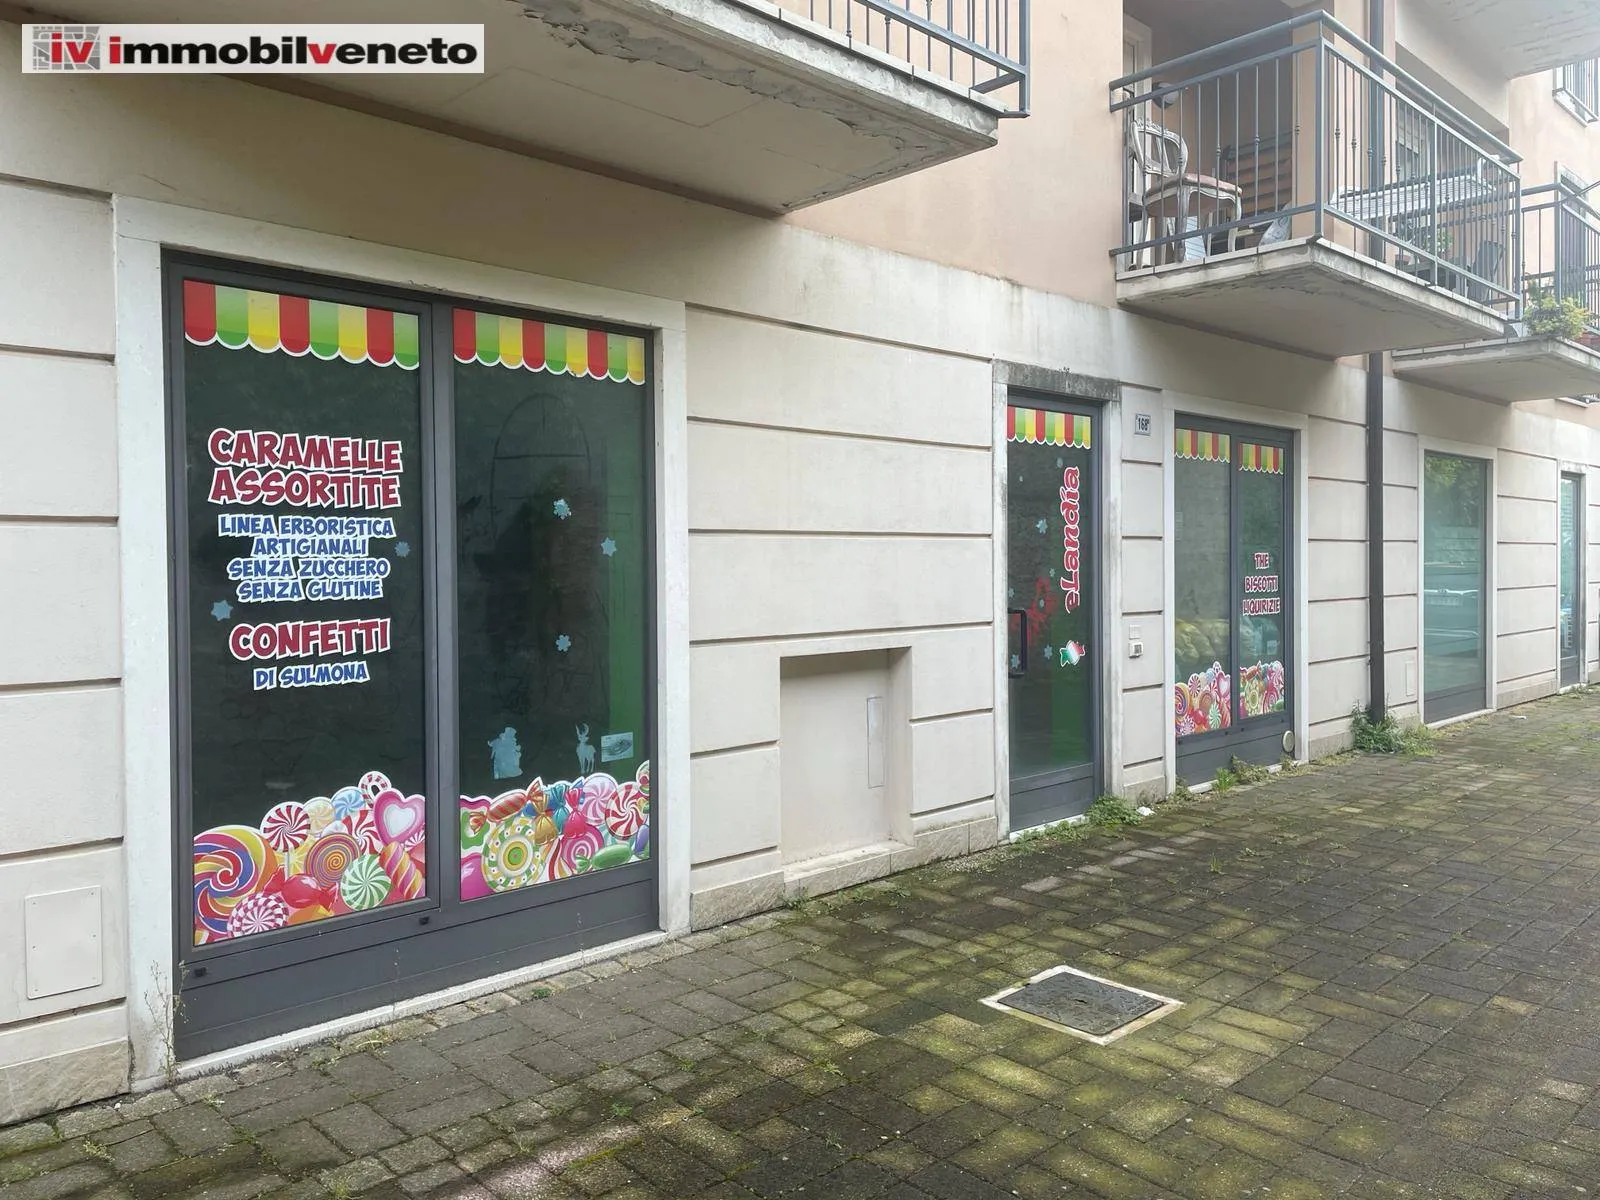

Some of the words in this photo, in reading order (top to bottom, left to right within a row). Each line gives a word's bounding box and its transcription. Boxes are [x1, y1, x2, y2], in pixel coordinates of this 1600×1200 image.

[208, 428, 403, 473] CARAMELLE
[208, 467, 402, 509] ASSORTITE
[218, 514, 277, 537] LINEA
[278, 515, 396, 538] ERBORISTICA
[251, 537, 369, 558] ARTIGIANALI
[227, 557, 293, 580] SENZA
[298, 558, 391, 579] ZUCCHERO
[1255, 552, 1269, 569] THE
[236, 578, 305, 602] SENZA
[306, 579, 384, 600] GLUTINE
[1245, 576, 1278, 593] BISCOTTI
[1243, 597, 1281, 616] LIQUIRIZIE
[229, 618, 391, 660] CONFETTI
[253, 667, 277, 690] DI
[279, 661, 370, 688] SULMONA
